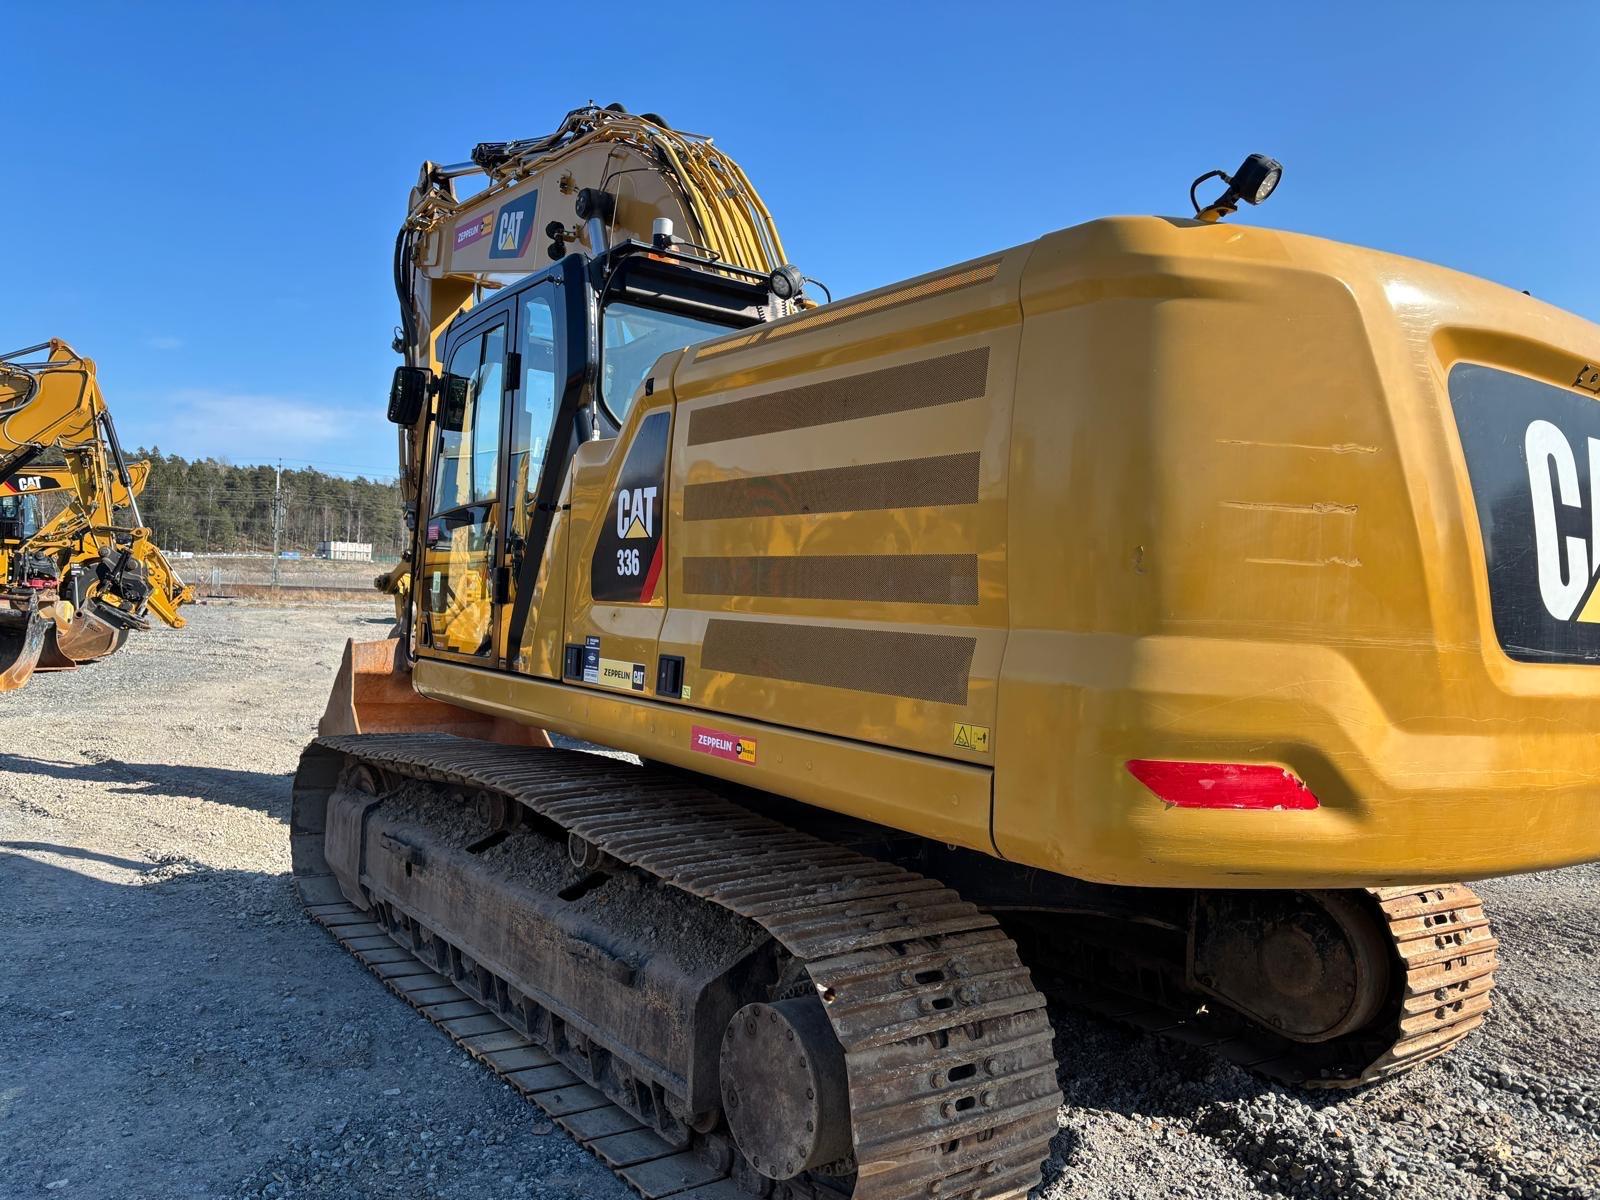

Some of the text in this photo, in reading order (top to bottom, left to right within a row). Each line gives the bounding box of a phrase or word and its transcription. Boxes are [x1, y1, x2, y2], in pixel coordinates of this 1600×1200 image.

[457, 225, 480, 243] ZEPPELIN
[498, 210, 524, 250] CAT
[18, 476, 42, 491] CAT
[616, 486, 657, 539] CAT
[1525, 419, 1600, 621] C
[616, 548, 640, 576] 336
[603, 668, 631, 680] ZEPPELIN
[633, 670, 644, 684] CAT
[698, 734, 733, 752] ZEPPELIN
